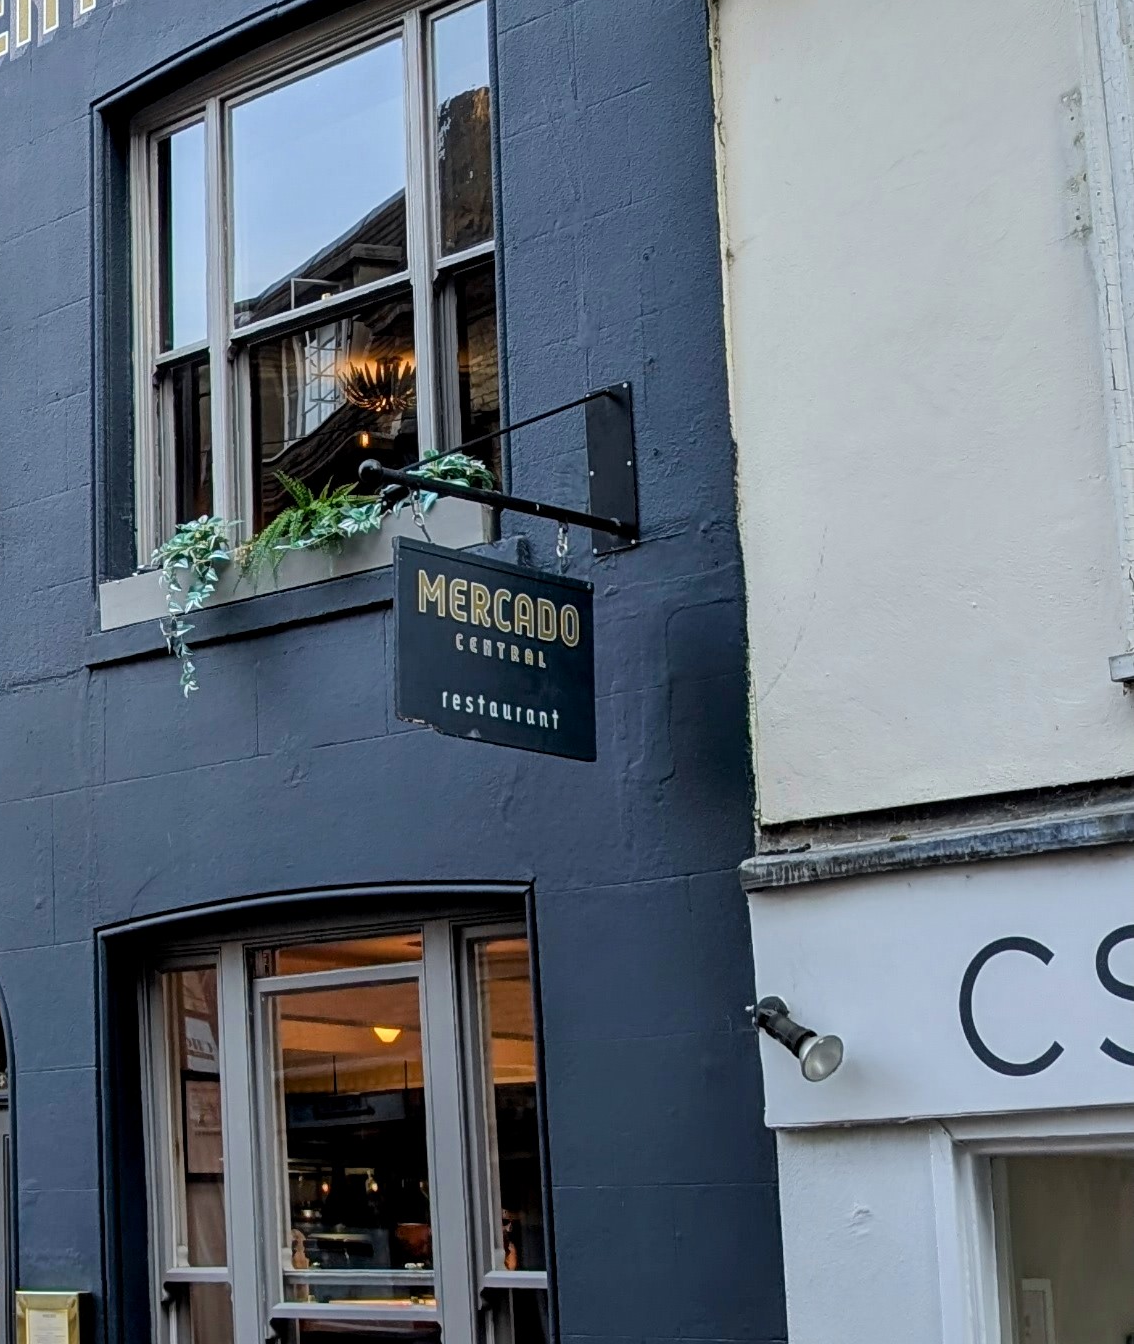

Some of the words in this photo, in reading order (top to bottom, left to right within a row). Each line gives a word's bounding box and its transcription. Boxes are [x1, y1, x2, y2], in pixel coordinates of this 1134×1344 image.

[418, 569, 580, 647] MERCADO
[456, 633, 546, 668] CENTRAL
[442, 691, 559, 729] restaurant
